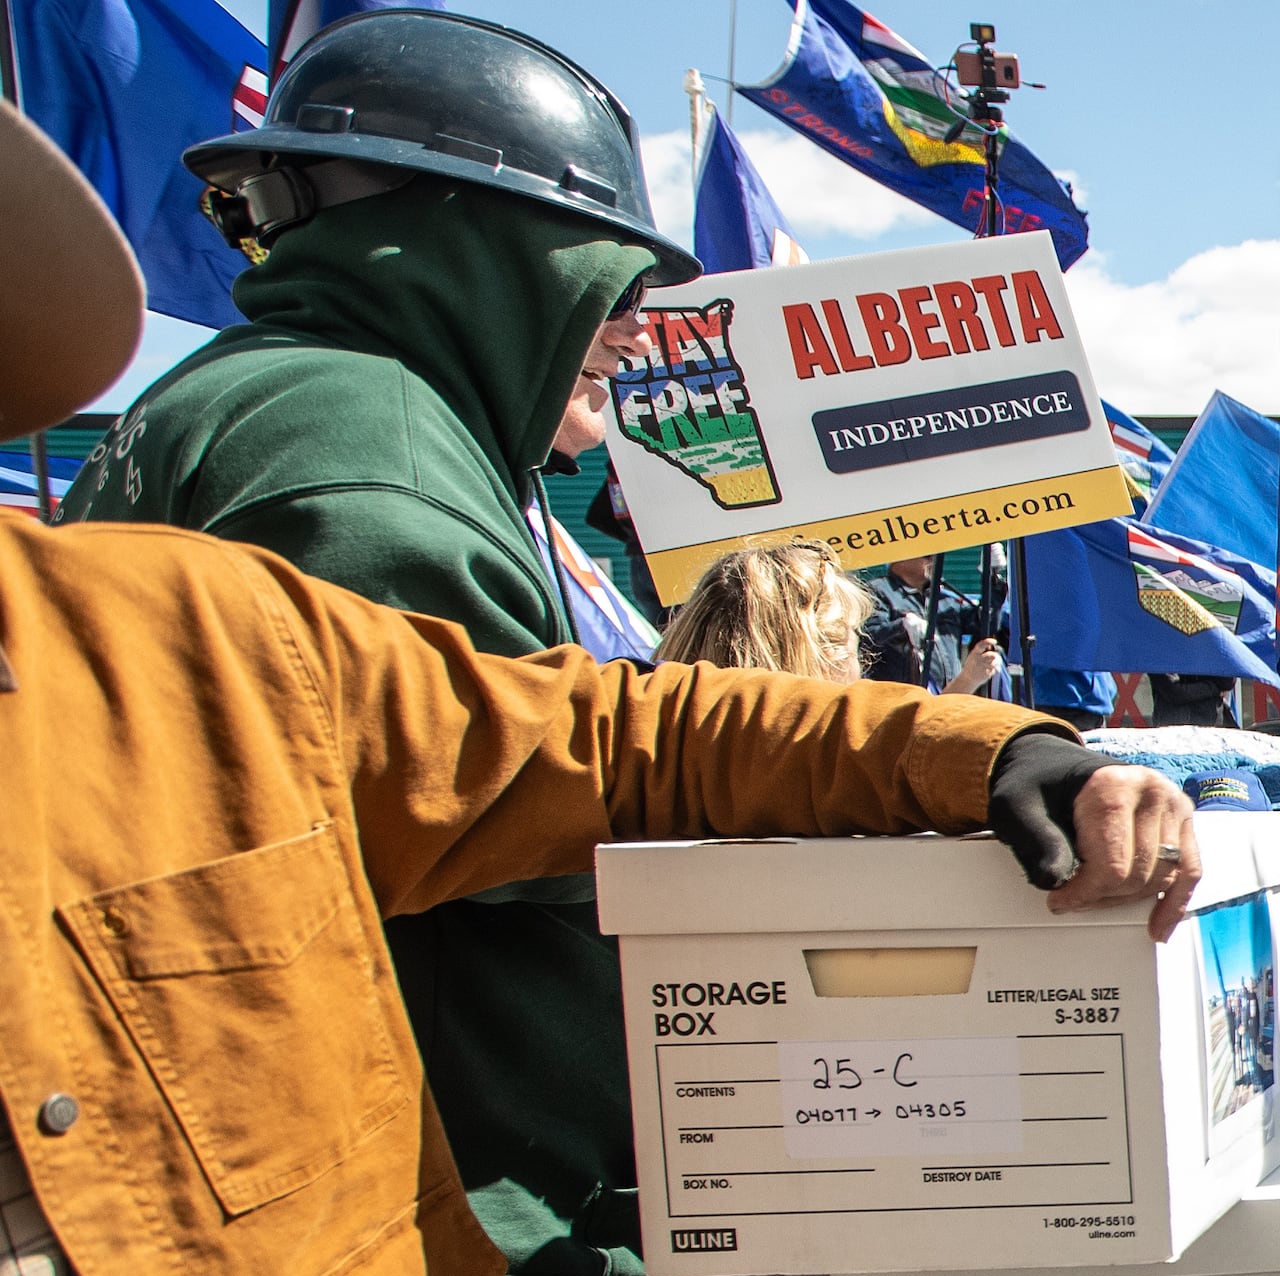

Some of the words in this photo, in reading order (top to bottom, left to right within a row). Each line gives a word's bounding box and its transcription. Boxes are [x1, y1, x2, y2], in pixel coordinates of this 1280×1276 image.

[961, 189, 1043, 233] FEE
[782, 269, 1065, 380] ALBERTA
[615, 369, 758, 451] FREE
[829, 391, 1073, 452] INDEPENDENCE
[792, 489, 1077, 554] eealberta.com
[652, 981, 787, 1008] STORAGE
[987, 988, 1087, 1004] LETTER/LEGAL
[1091, 987, 1120, 1001] SIZE
[655, 1012, 717, 1037] BOX
[1055, 1007, 1120, 1024] S-3887
[676, 1086, 736, 1098] CONTENTS
[795, 1107, 858, 1124] 04077
[895, 1100, 967, 1119] 04305
[679, 1133, 714, 1144] FROM
[683, 1180, 708, 1190] BOX
[710, 1179, 733, 1189] NO.
[923, 1172, 972, 1183] DESTROY
[974, 1171, 1002, 1182] DATE
[1042, 1215, 1135, 1229] 1-800-295-5510
[674, 1231, 735, 1250] ULINE
[1088, 1230, 1136, 1240] uline.com
